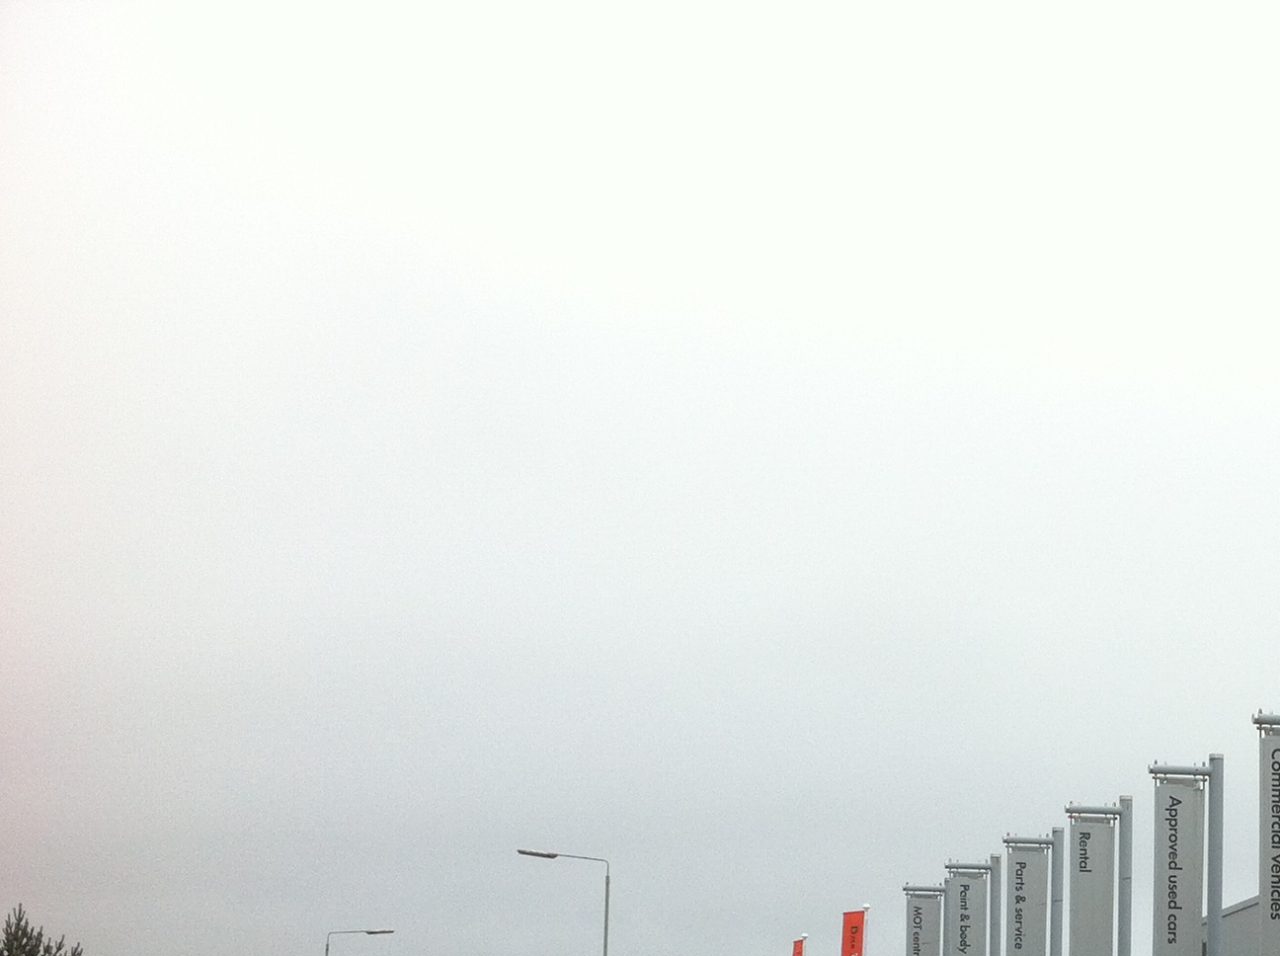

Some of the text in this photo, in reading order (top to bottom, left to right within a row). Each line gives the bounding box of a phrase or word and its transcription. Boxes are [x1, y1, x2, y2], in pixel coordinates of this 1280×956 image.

[1079, 832, 1092, 872] Rental
[1165, 795, 1183, 944] Approved used cars
[912, 906, 922, 930] MOT
[957, 884, 971, 954] Paint & body
[1014, 861, 1026, 950] Parts & service
